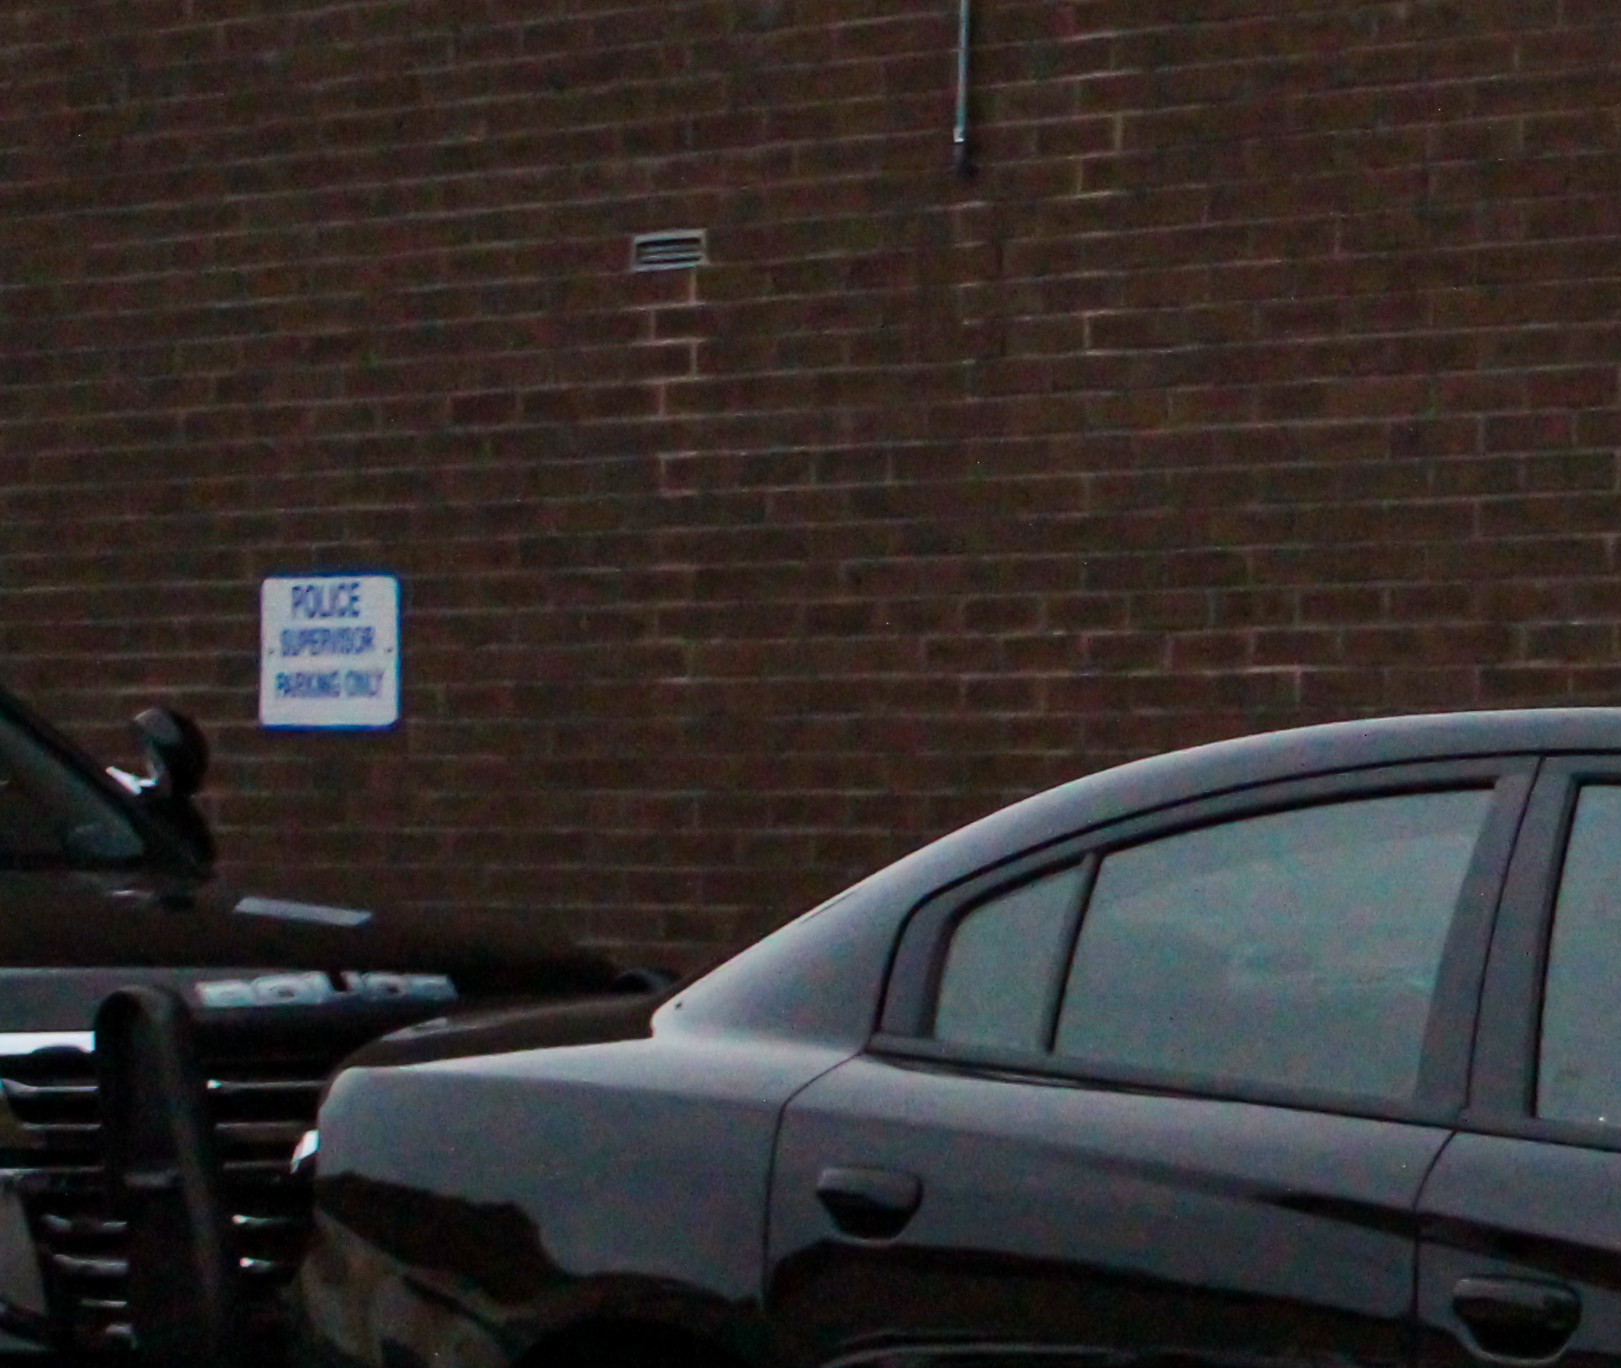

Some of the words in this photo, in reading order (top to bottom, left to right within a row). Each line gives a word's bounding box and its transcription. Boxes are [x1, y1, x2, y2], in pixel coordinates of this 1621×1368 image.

[291, 582, 360, 618] POLICE
[276, 671, 341, 697] PARKING
[346, 670, 384, 697] ONLY
